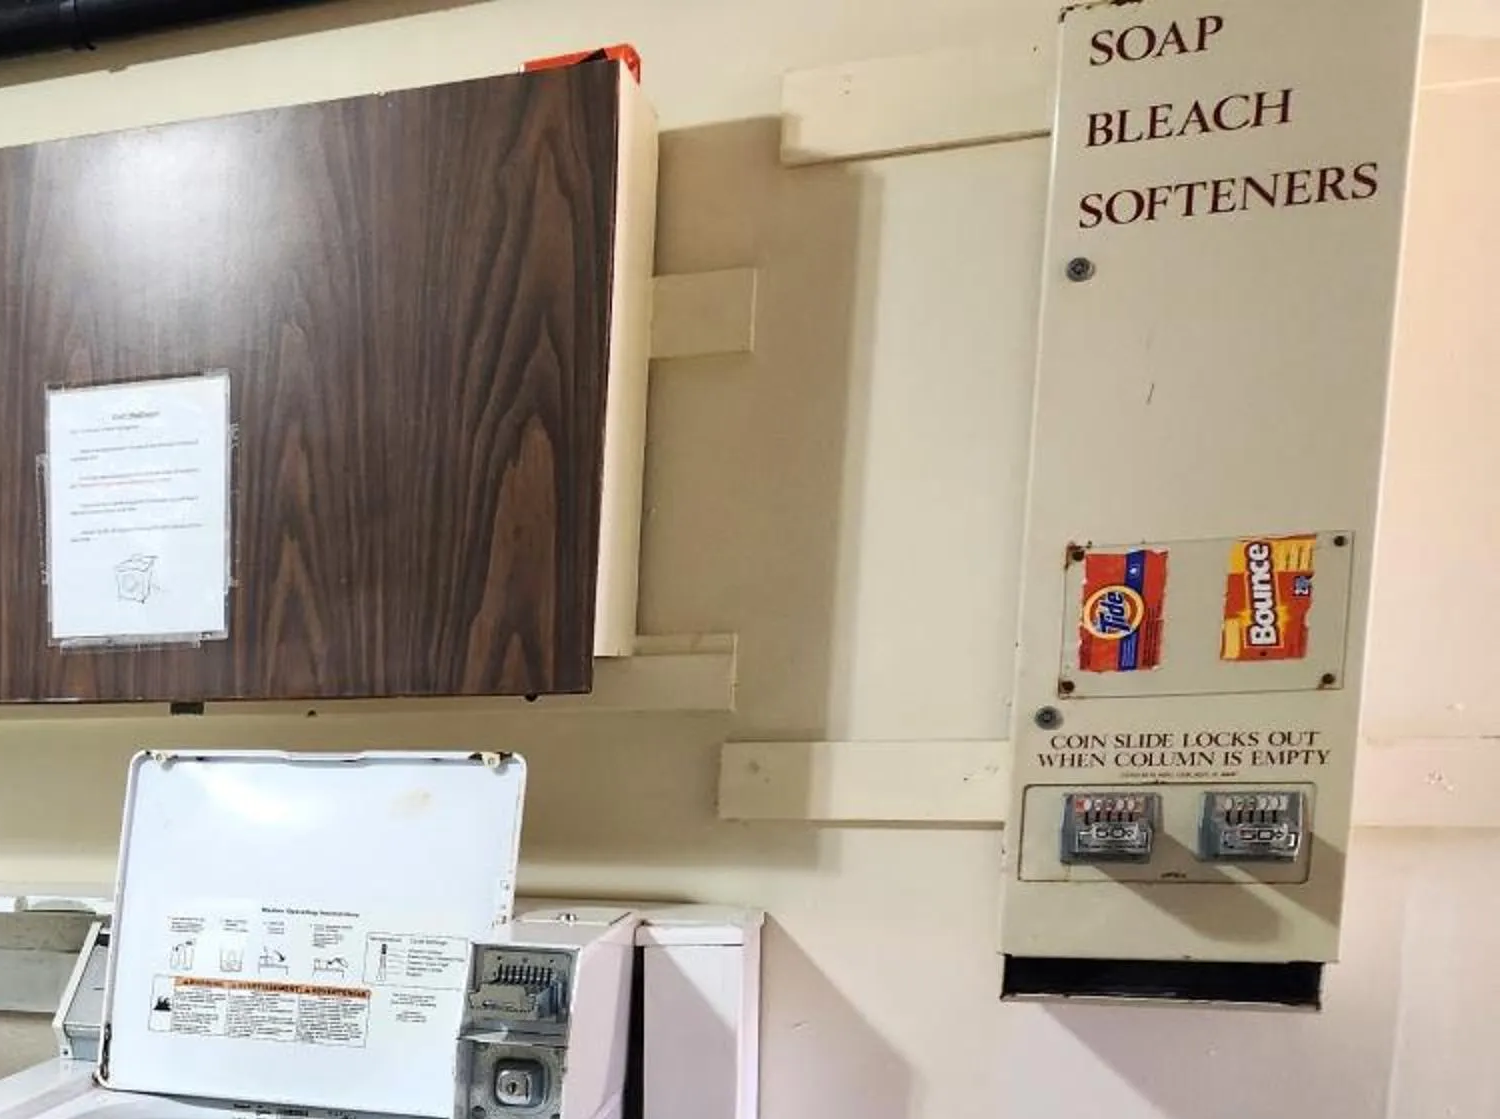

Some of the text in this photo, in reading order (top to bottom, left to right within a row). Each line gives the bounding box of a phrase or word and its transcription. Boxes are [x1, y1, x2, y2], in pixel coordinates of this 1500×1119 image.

[1088, 14, 1224, 67] SOAP
[1085, 87, 1296, 148] BLEACH
[1078, 161, 1379, 230] SOFTENERS
[1099, 591, 1131, 633] Tide
[1249, 542, 1277, 645] Bounce
[1037, 749, 1331, 768] WHEN COLUMN IS EMPTY
[1050, 731, 1322, 749] COIN SLIDE LOCKS OUT
